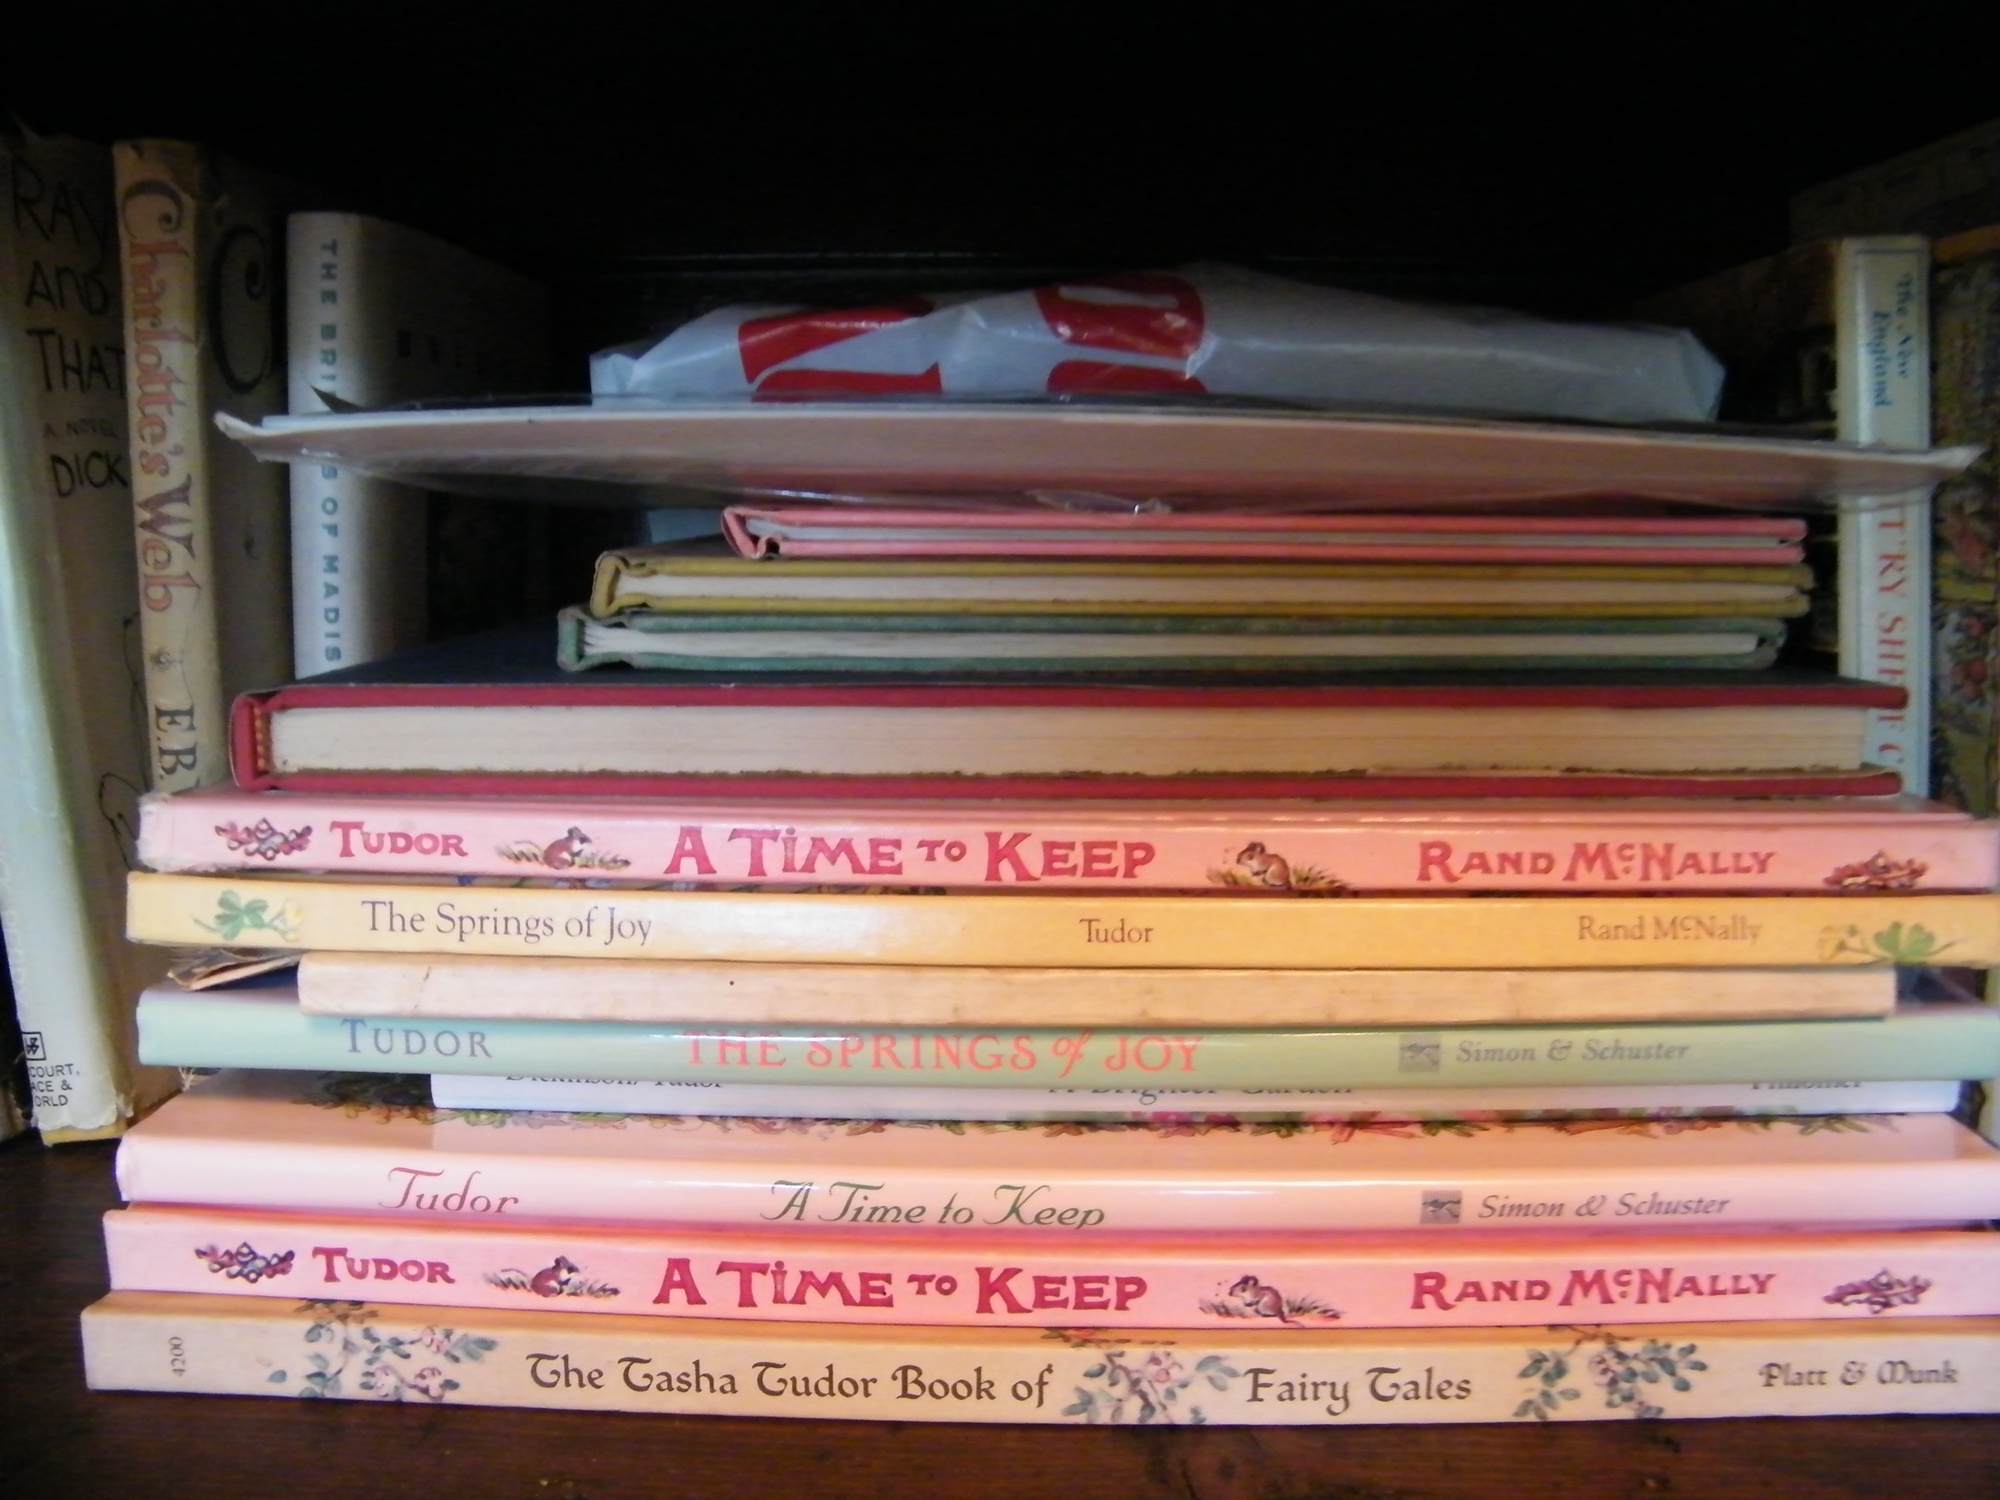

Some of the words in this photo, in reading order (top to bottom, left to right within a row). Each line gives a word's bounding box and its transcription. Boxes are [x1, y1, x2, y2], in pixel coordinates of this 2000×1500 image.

[320, 238, 338, 305] THE
[121, 179, 199, 477] Charlotte's
[50, 450, 129, 498] DICK
[137, 473, 201, 612] Web
[320, 496, 339, 539] OF
[321, 554, 343, 665] MADIS
[330, 821, 469, 858] TUDOR
[663, 825, 717, 875] A
[984, 831, 1156, 882] KEEP
[1416, 840, 1555, 883] RAND
[362, 900, 425, 933] The
[435, 902, 555, 943] Springs
[565, 905, 598, 938] of
[603, 907, 652, 946] Joy
[1079, 918, 1155, 944] Tudor
[1578, 915, 1647, 942] Rand
[1653, 914, 1762, 945] McNally
[28, 1062, 80, 1078] COURT,
[340, 1018, 493, 1059] TUDOR
[683, 1029, 787, 1068] THE
[806, 1032, 1039, 1071] SPRINGS
[1052, 1027, 1094, 1078] of
[1104, 1035, 1204, 1073] JOY
[1456, 1040, 1537, 1063] Simon
[1546, 1039, 1574, 1062] &
[1582, 1039, 1690, 1063] Schuster
[30, 1080, 54, 1093] ACE
[61, 1079, 73, 1091] &
[34, 1094, 69, 1108] ORLD
[378, 1166, 519, 1214] Tudor
[760, 1178, 814, 1224] A
[816, 1181, 927, 1225] Time
[937, 1191, 974, 1225] to
[992, 1184, 1106, 1230] Keep
[1478, 1194, 1565, 1218] Simon
[1574, 1195, 1607, 1217] &
[1614, 1191, 1732, 1218] Schuster
[312, 1246, 456, 1284] TUDOR
[652, 1257, 708, 1305] A
[975, 1266, 1149, 1315] KEEP
[1410, 1270, 1550, 1311] RAND
[170, 1336, 187, 1378] 4200
[526, 1353, 605, 1390] The
[617, 1356, 738, 1397] Tasha
[752, 1361, 878, 1399] Tudor
[890, 1364, 997, 1401] Book
[1010, 1362, 1056, 1409] of
[1241, 1366, 1350, 1417] Fairy
[1365, 1365, 1473, 1403] Tales
[1758, 1361, 1828, 1388] Platt
[1840, 1359, 1866, 1385] &
[1877, 1360, 1960, 1386] Munk
